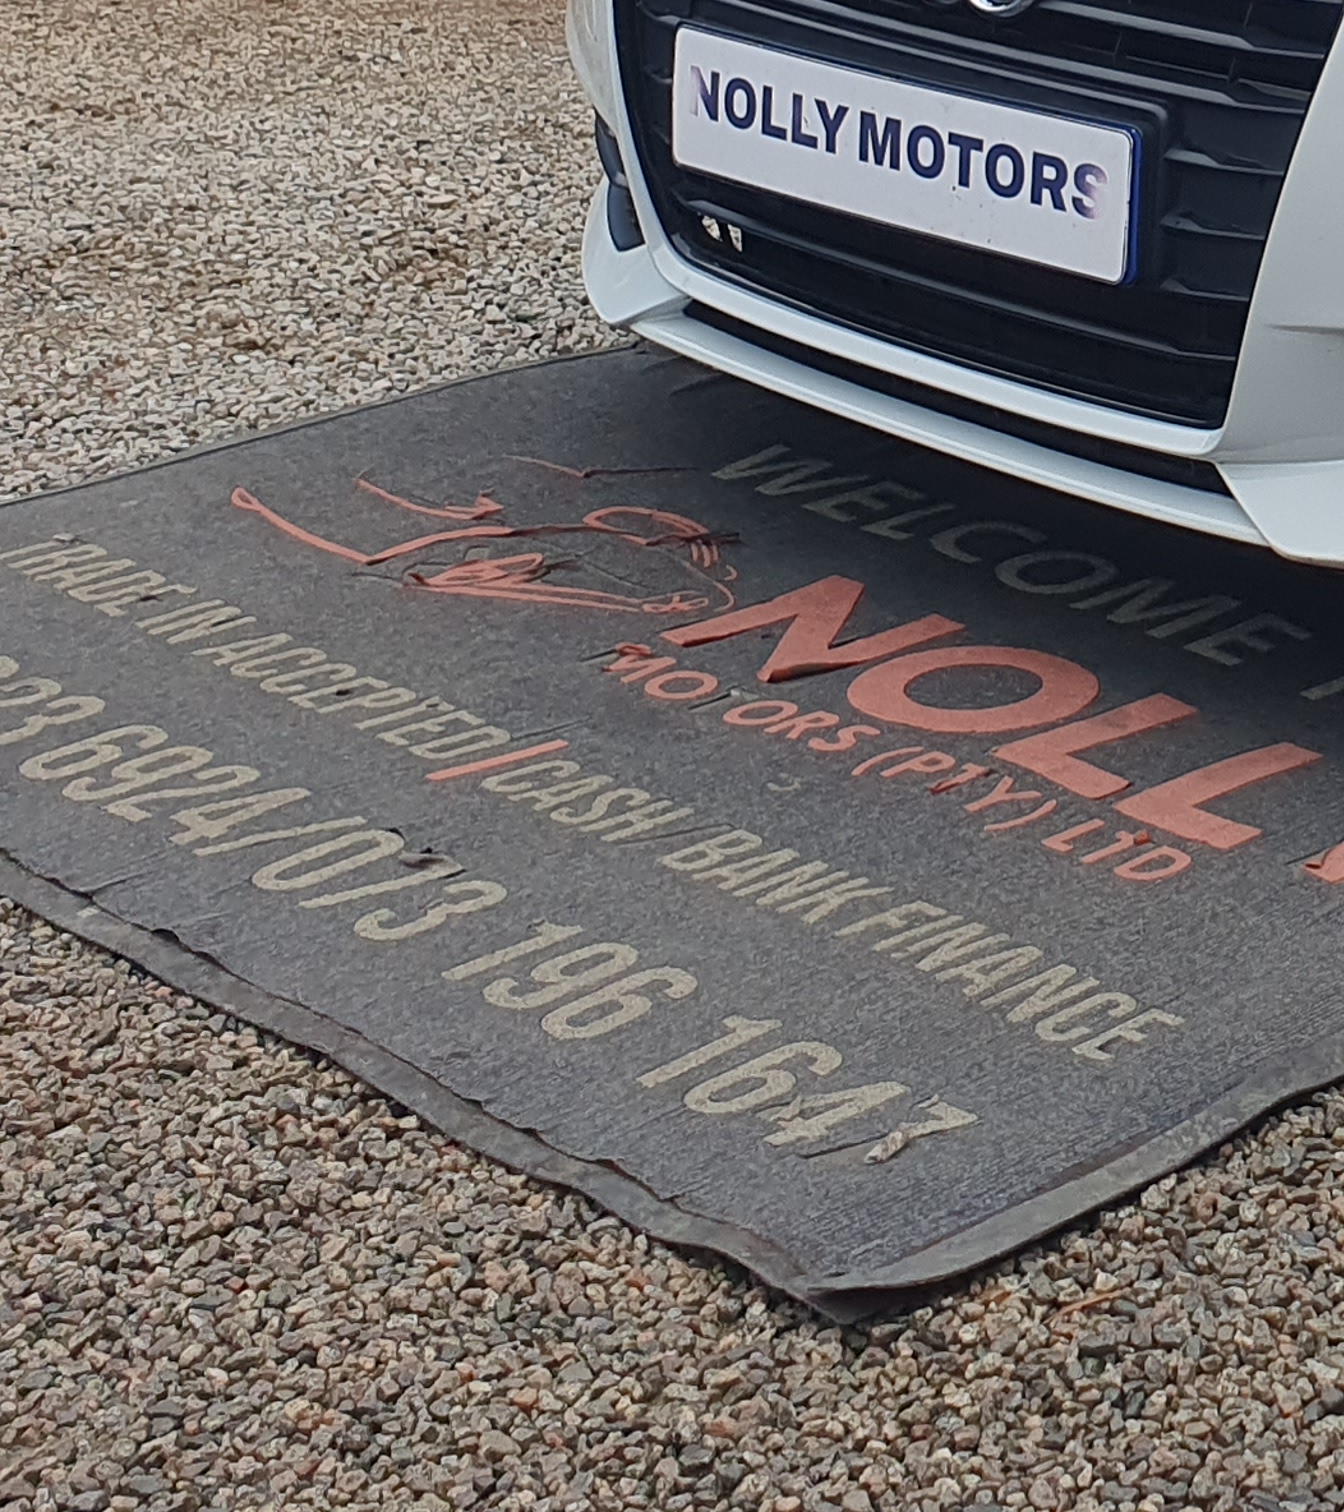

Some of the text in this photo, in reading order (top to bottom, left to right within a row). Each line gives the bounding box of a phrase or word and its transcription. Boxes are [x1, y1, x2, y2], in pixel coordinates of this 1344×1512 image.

[690, 65, 1107, 220] NOLLY MOTORS
[710, 443, 1313, 667] WELCOME
[0, 533, 198, 617] TRADE
[134, 598, 258, 645] IN
[657, 828, 897, 925] BANK
[833, 899, 1187, 1061] FINANCE
[1041, 818, 1193, 881] LTD
[440, 918, 699, 1042] 196
[635, 1013, 984, 1165] 1647
